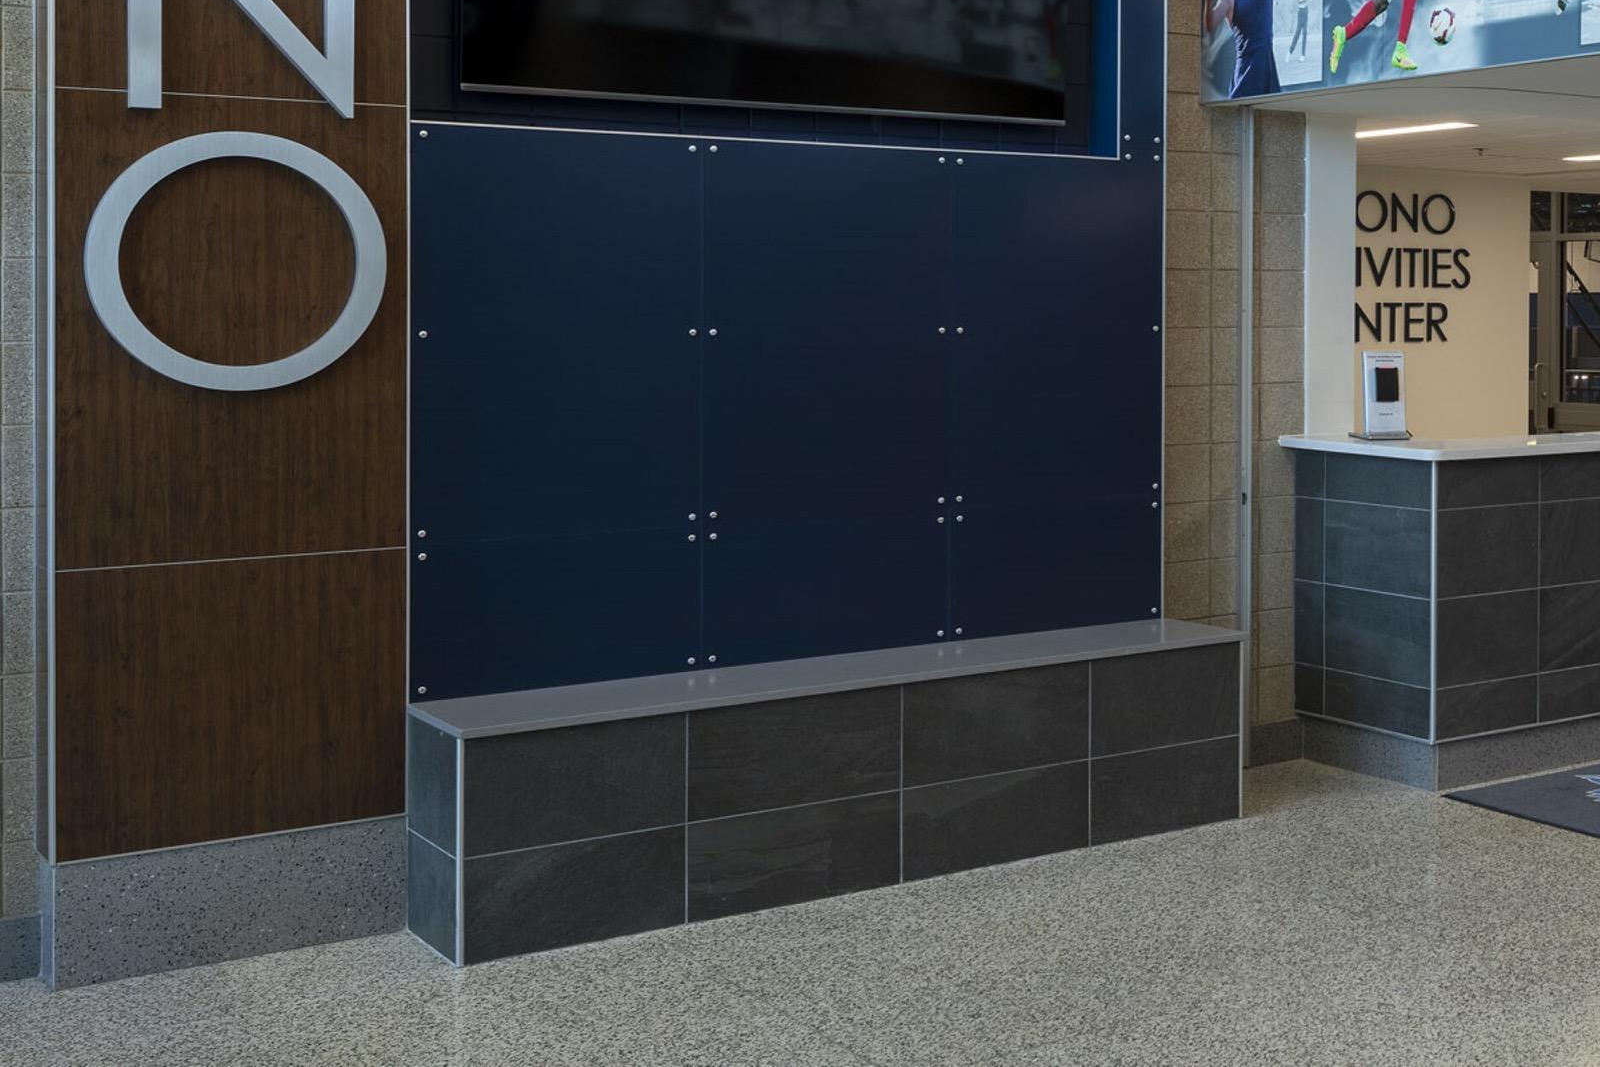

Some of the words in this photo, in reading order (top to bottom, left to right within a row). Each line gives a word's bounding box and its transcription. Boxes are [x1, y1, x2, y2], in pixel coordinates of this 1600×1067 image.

[1356, 190, 1456, 235] ONO
[1355, 246, 1471, 289] IVITIES
[1354, 302, 1449, 343] NTER
